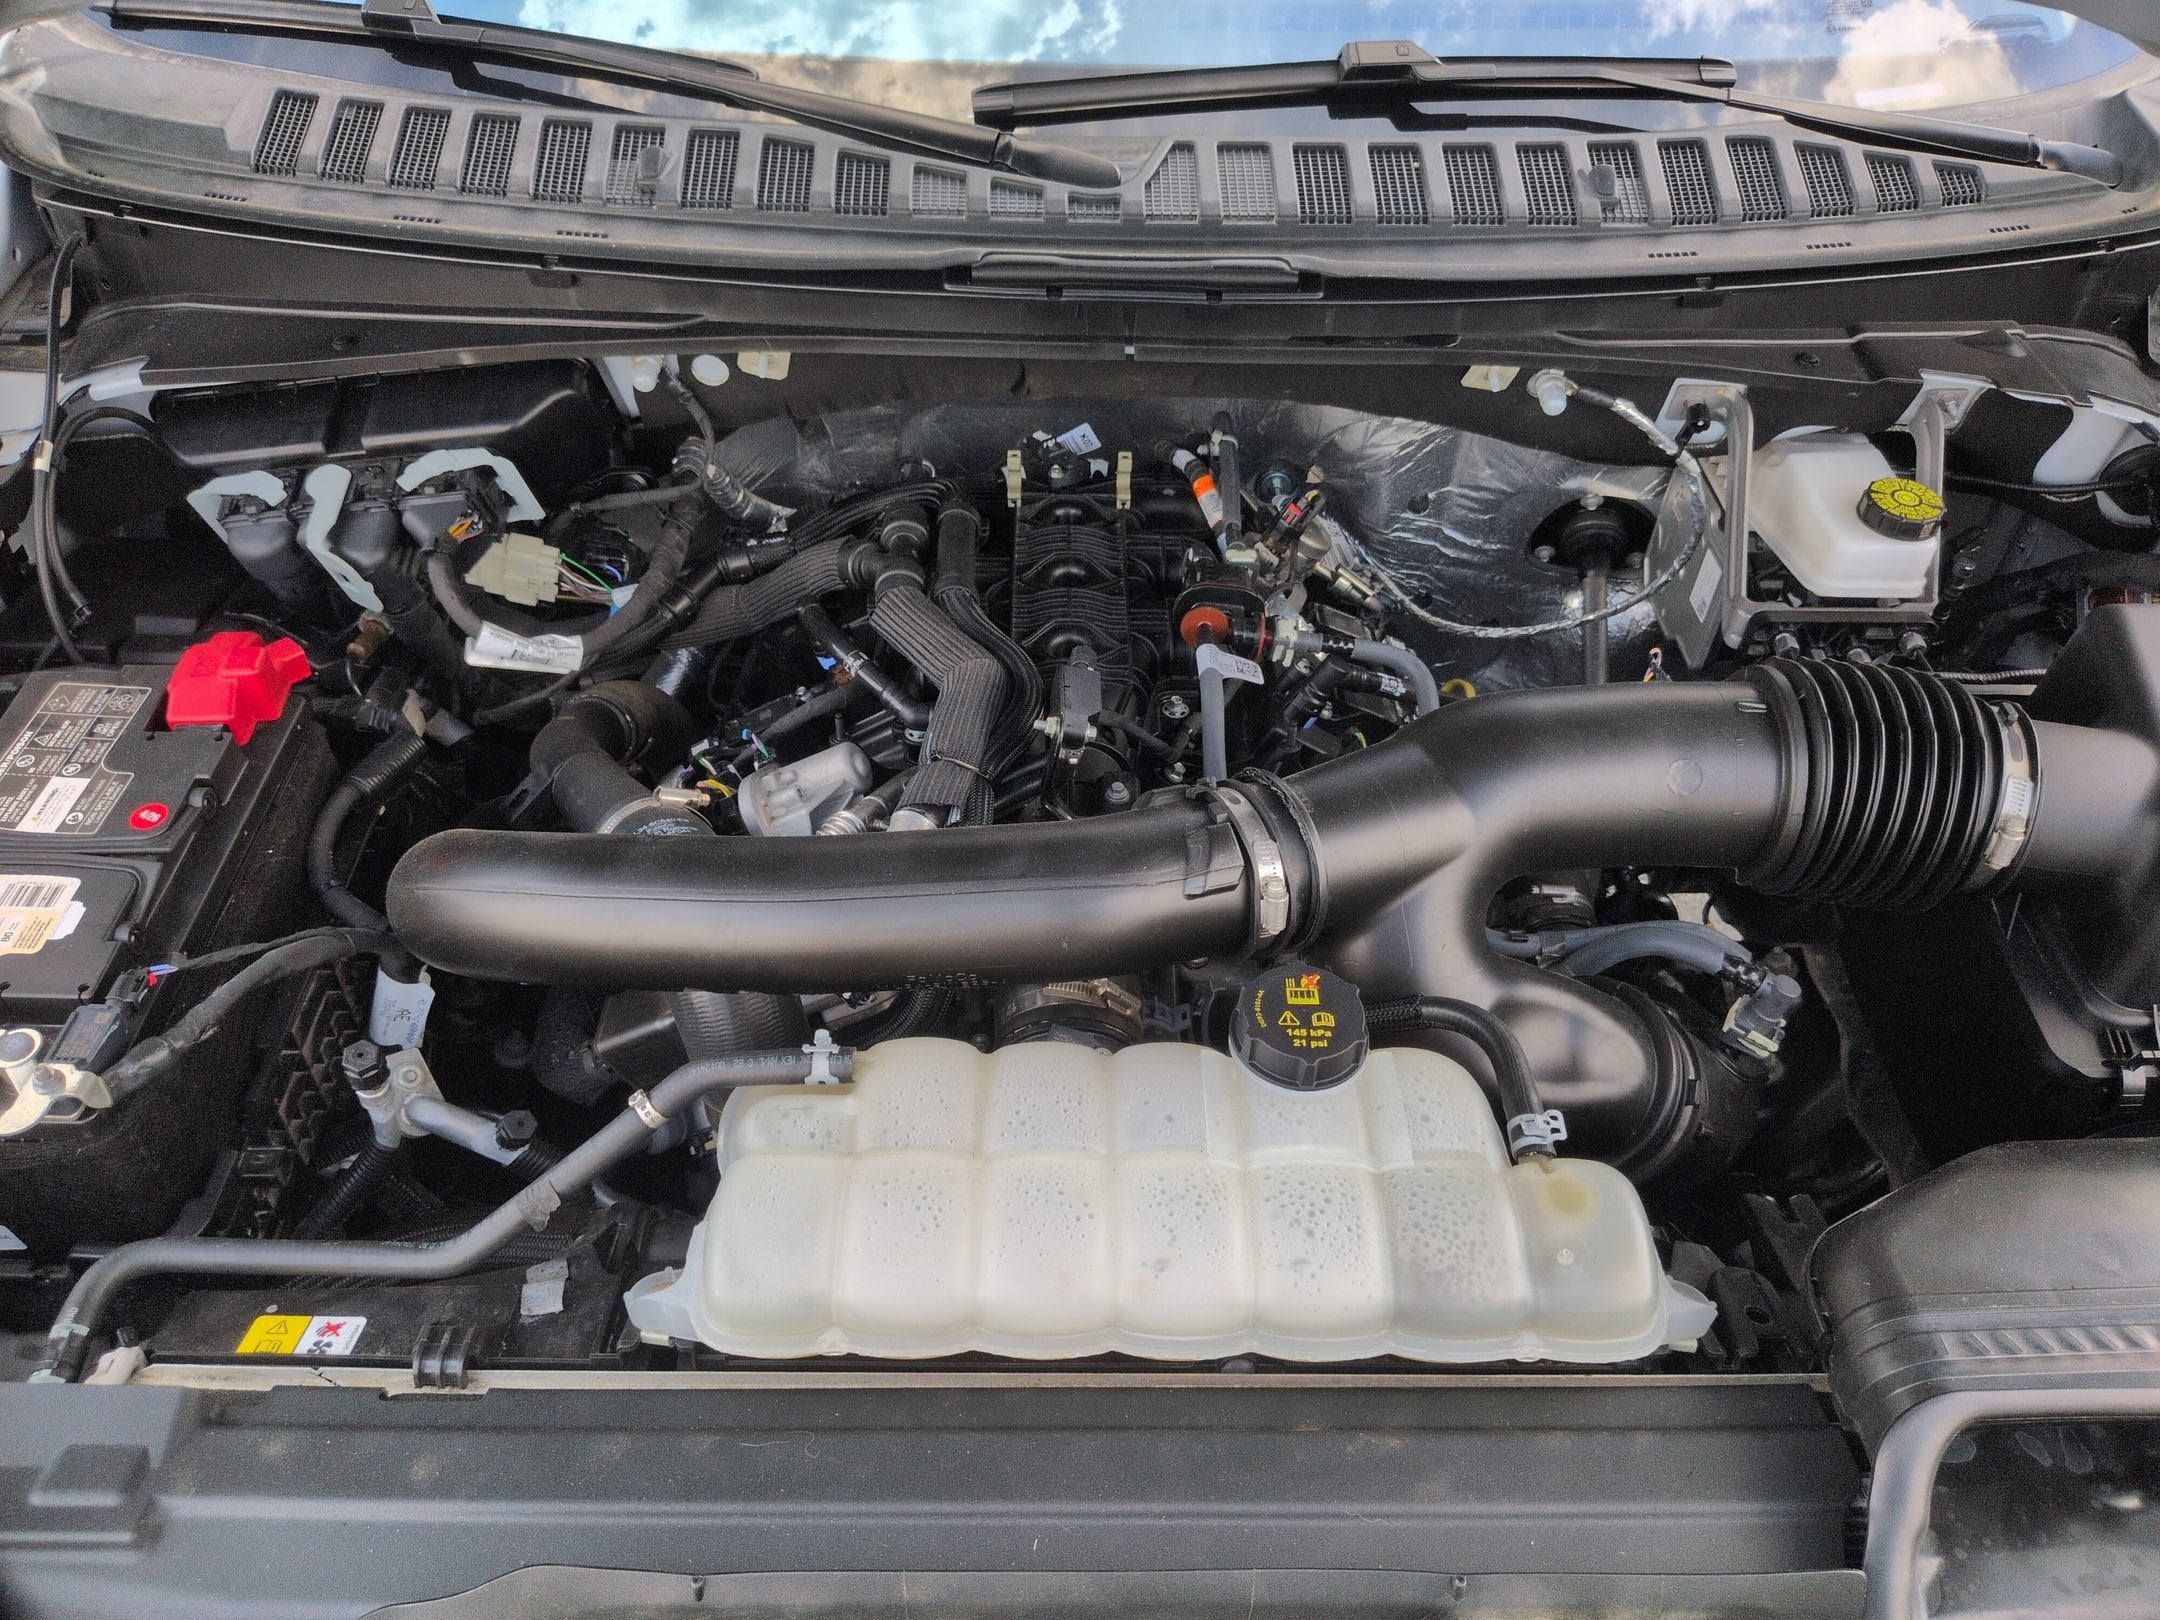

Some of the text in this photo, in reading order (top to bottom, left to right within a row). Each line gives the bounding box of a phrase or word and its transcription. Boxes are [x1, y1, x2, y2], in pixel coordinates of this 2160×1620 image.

[93, 724, 104, 733] DO
[101, 722, 113, 735] NOT
[1286, 1028, 1332, 1037] 145 kPa
[1293, 1039, 1328, 1048] 21 psi
